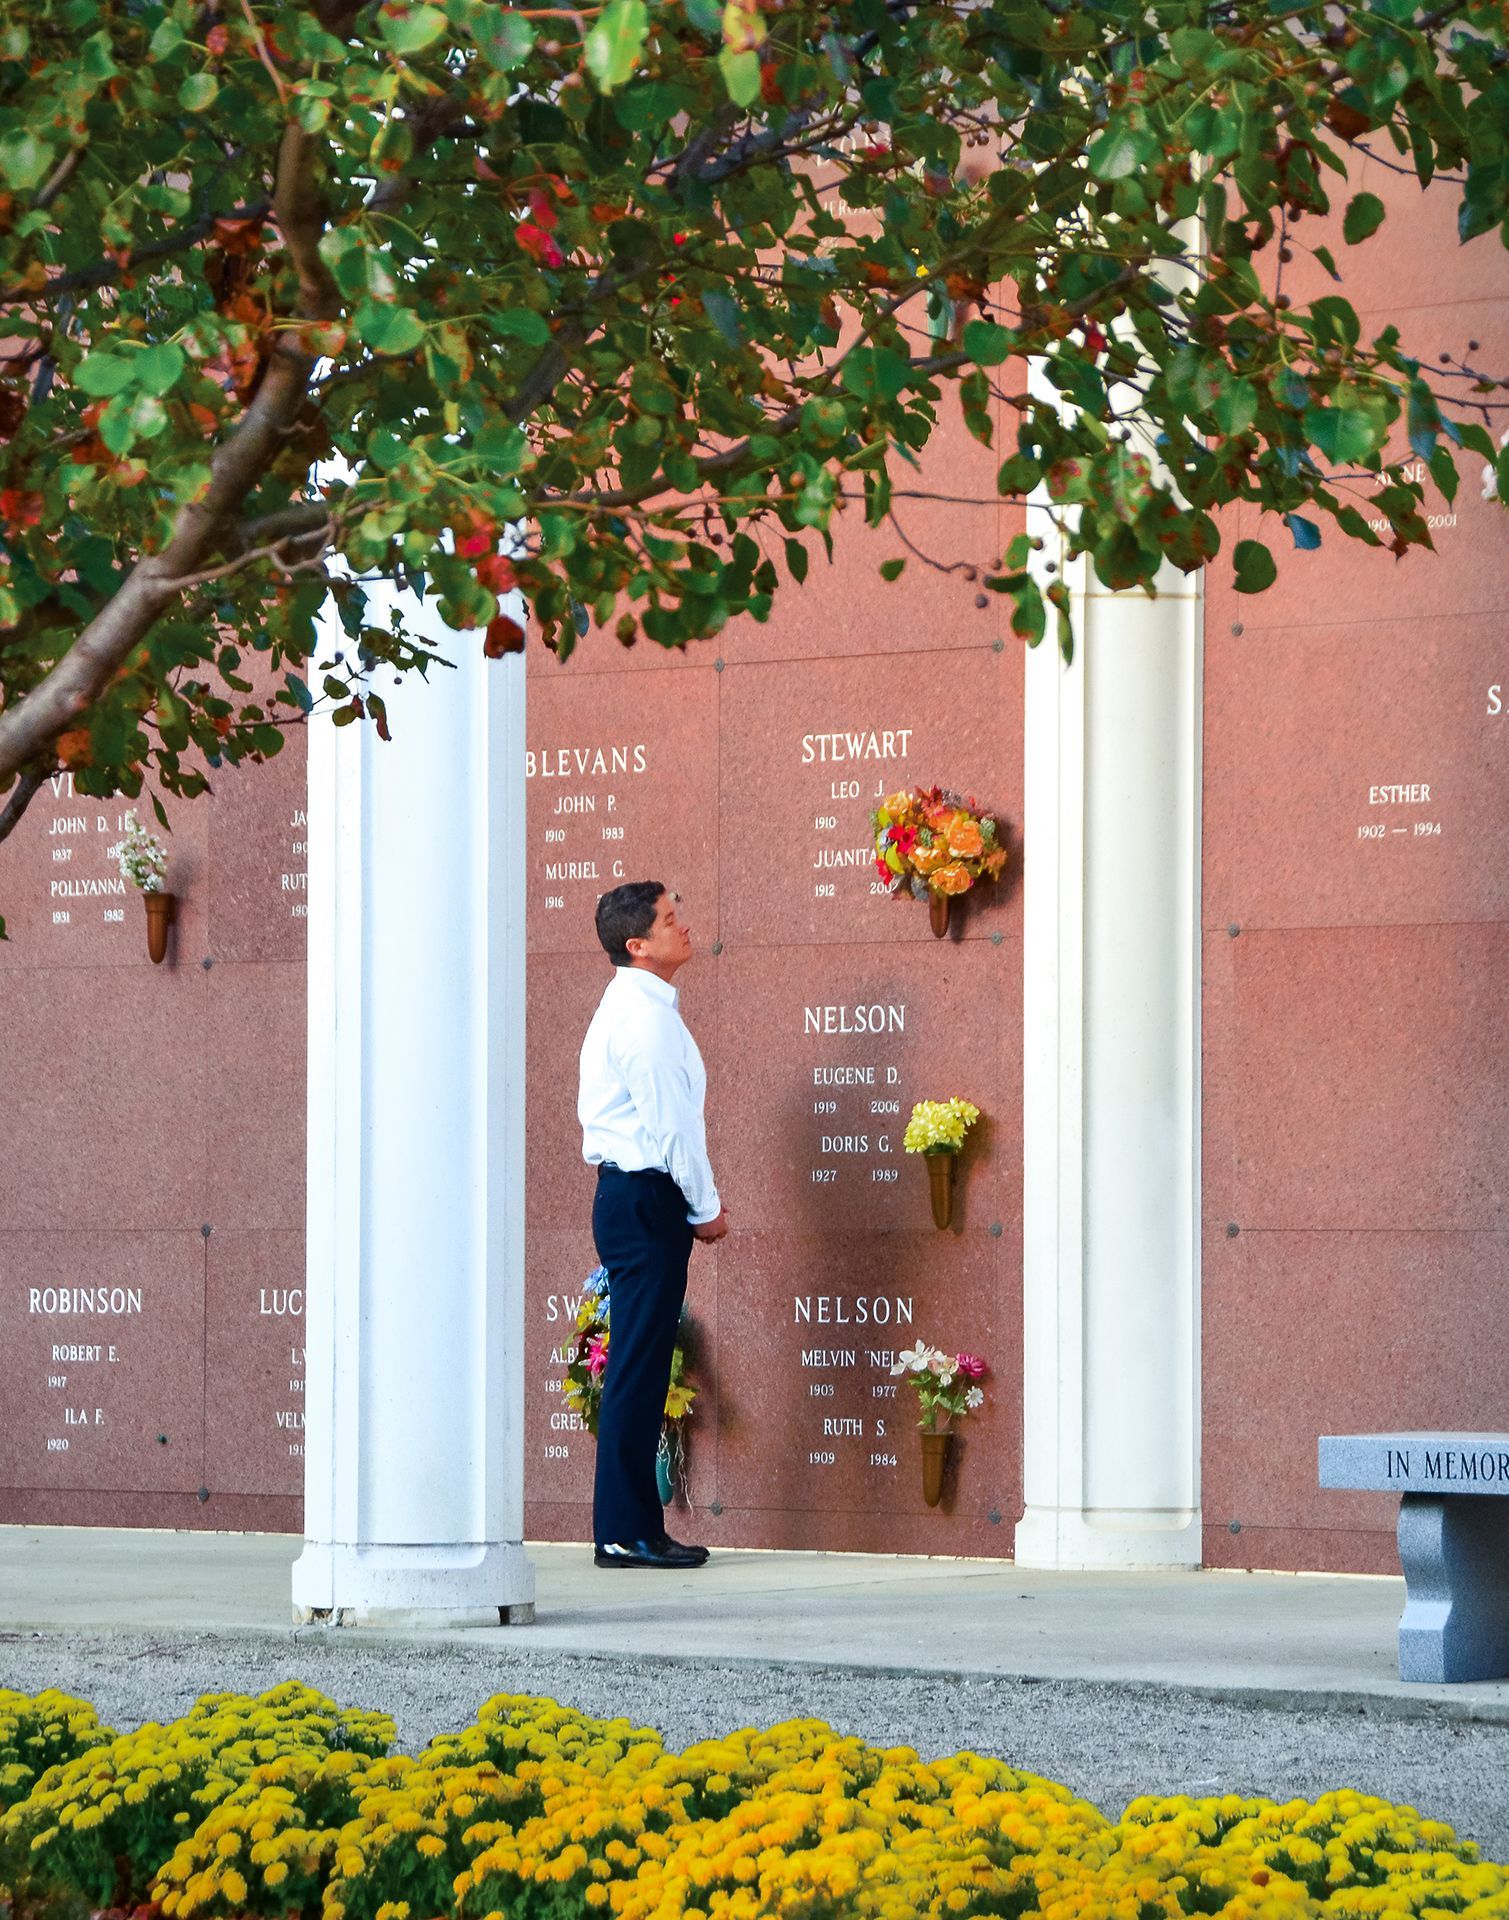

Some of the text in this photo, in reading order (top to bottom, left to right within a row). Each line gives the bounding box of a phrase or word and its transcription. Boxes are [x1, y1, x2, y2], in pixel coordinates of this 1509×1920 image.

[1367, 513, 1457, 532] 190 2001
[801, 729, 913, 763] STEWART
[526, 744, 647, 778] BLEVANS
[831, 779, 885, 799] LEO J.
[1368, 783, 1431, 805] ESTHER
[553, 794, 617, 815] JOHN P.
[49, 816, 87, 836] JOHN
[97, 815, 109, 832] D.
[290, 809, 309, 828] JA
[815, 815, 837, 830] 1910
[545, 826, 624, 843] 1910 1983
[1357, 824, 1386, 839] 1902
[1413, 822, 1442, 836] 1994
[52, 846, 121, 861] 1937 198
[292, 841, 309, 855] 190
[814, 847, 877, 868] JUANITA
[545, 860, 626, 880] MURIEL G.
[50, 878, 126, 898] POLLYANNA
[815, 883, 836, 897] 1912
[291, 904, 309, 918] 190
[545, 896, 565, 909] 1916
[52, 908, 125, 924] 1931 1982
[803, 1004, 906, 1034] NELSON
[813, 1066, 902, 1085] EUGENE D.
[813, 1100, 900, 1114] 1919 2006
[821, 1135, 893, 1154] DORIS G.
[811, 1168, 899, 1182] 1927 1989
[28, 1287, 143, 1314] ROBINSON
[545, 1295, 584, 1322] SW
[793, 1295, 914, 1325] NELSON
[51, 1344, 121, 1363] ROBERT E.
[801, 1349, 856, 1368] MELVIN
[47, 1375, 67, 1388] 1917
[288, 1380, 306, 1392] 191
[545, 1380, 565, 1393] 189
[809, 1384, 897, 1398] 1903 1977
[64, 1408, 106, 1426] ILA F.
[550, 1412, 590, 1431] GRET
[823, 1418, 887, 1437] RUTH S.
[47, 1438, 69, 1451] 1920
[288, 1443, 306, 1456] 191
[544, 1445, 570, 1458] 1908
[809, 1451, 898, 1467] 1909 1984
[1386, 1450, 1509, 1482] IN MEMOR
